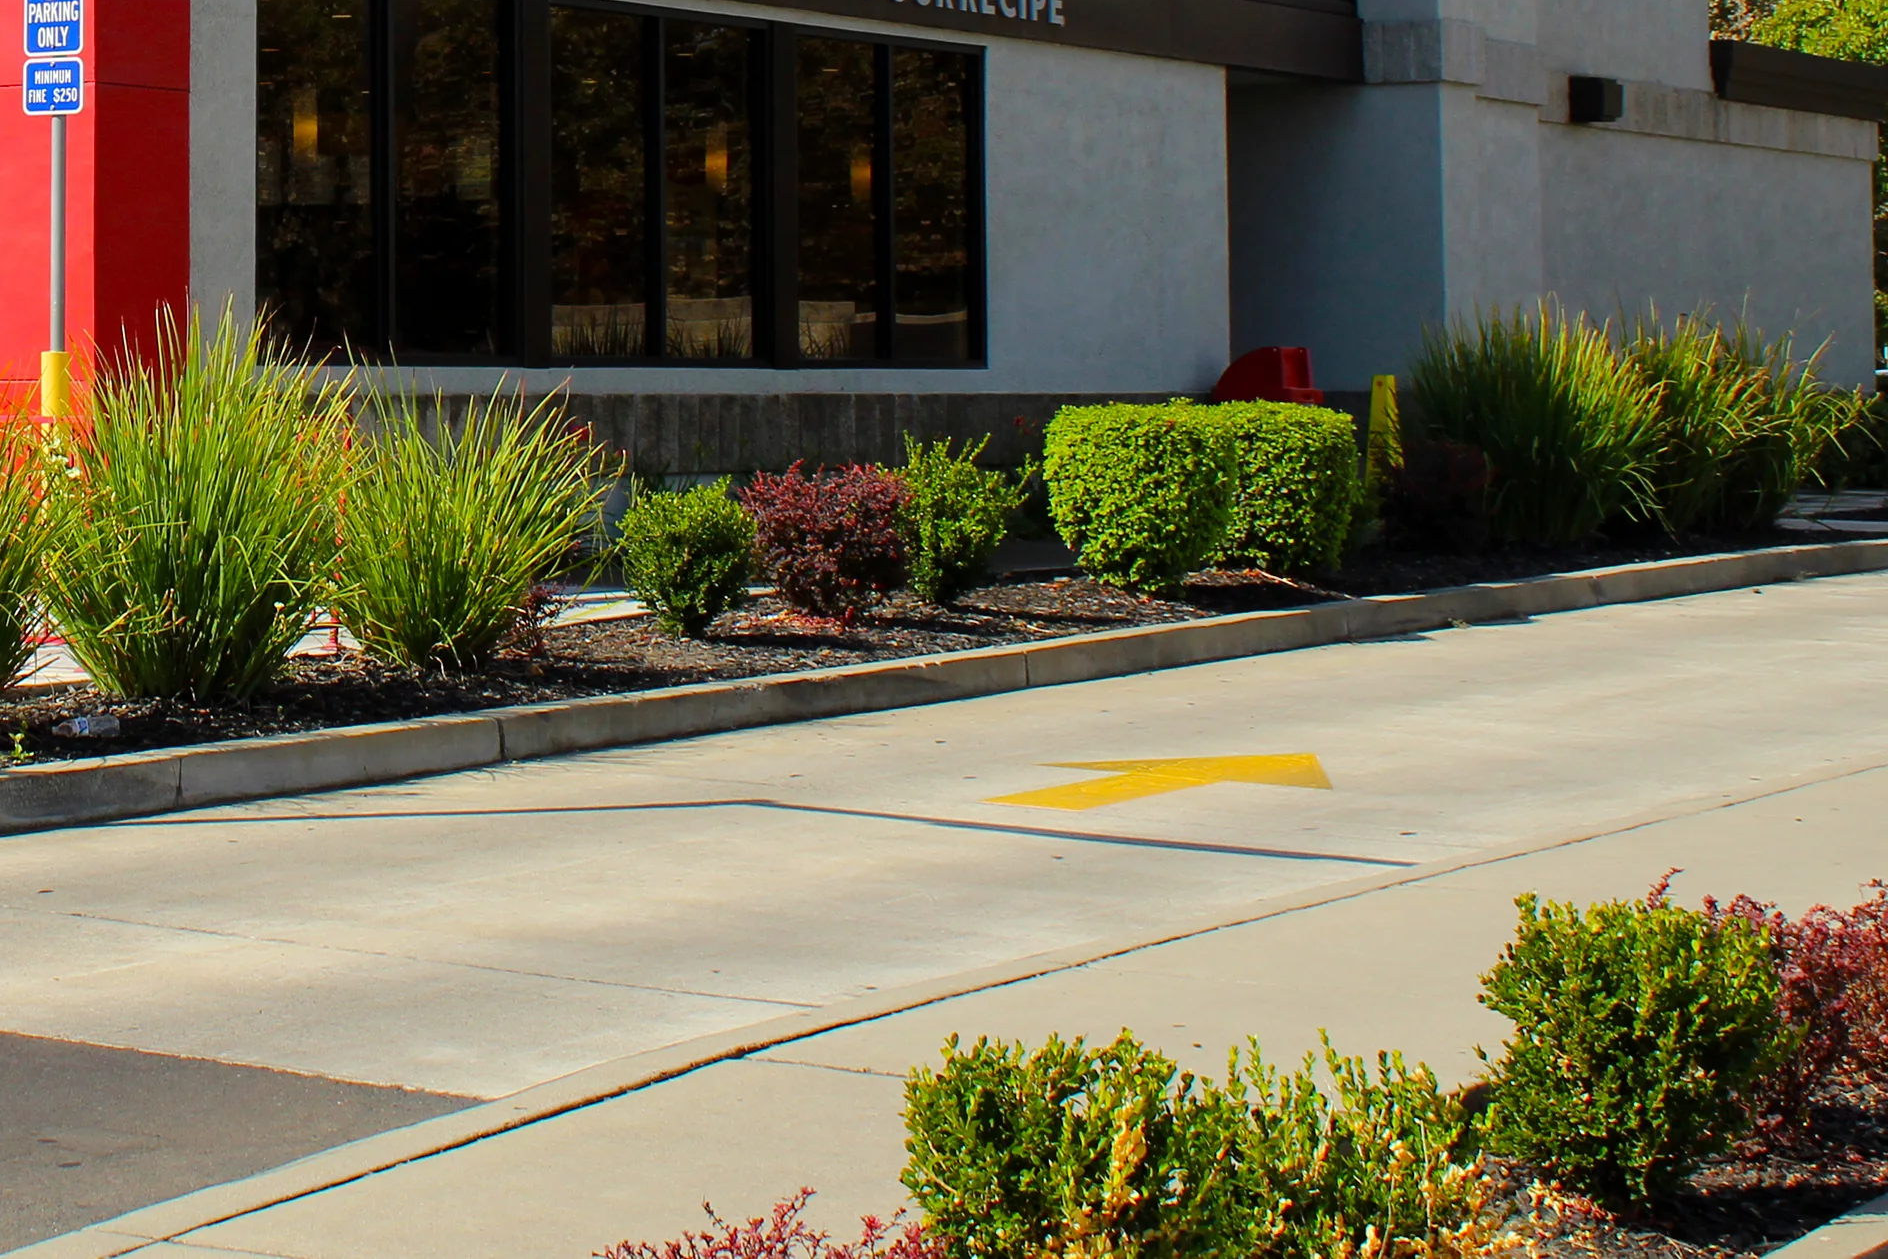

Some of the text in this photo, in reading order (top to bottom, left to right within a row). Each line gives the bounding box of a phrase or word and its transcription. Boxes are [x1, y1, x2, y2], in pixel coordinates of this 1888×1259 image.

[28, 0, 79, 24] PARKING
[37, 25, 70, 48] ONLY
[34, 69, 72, 85] MINIMUM
[28, 87, 78, 104] FINE $250
